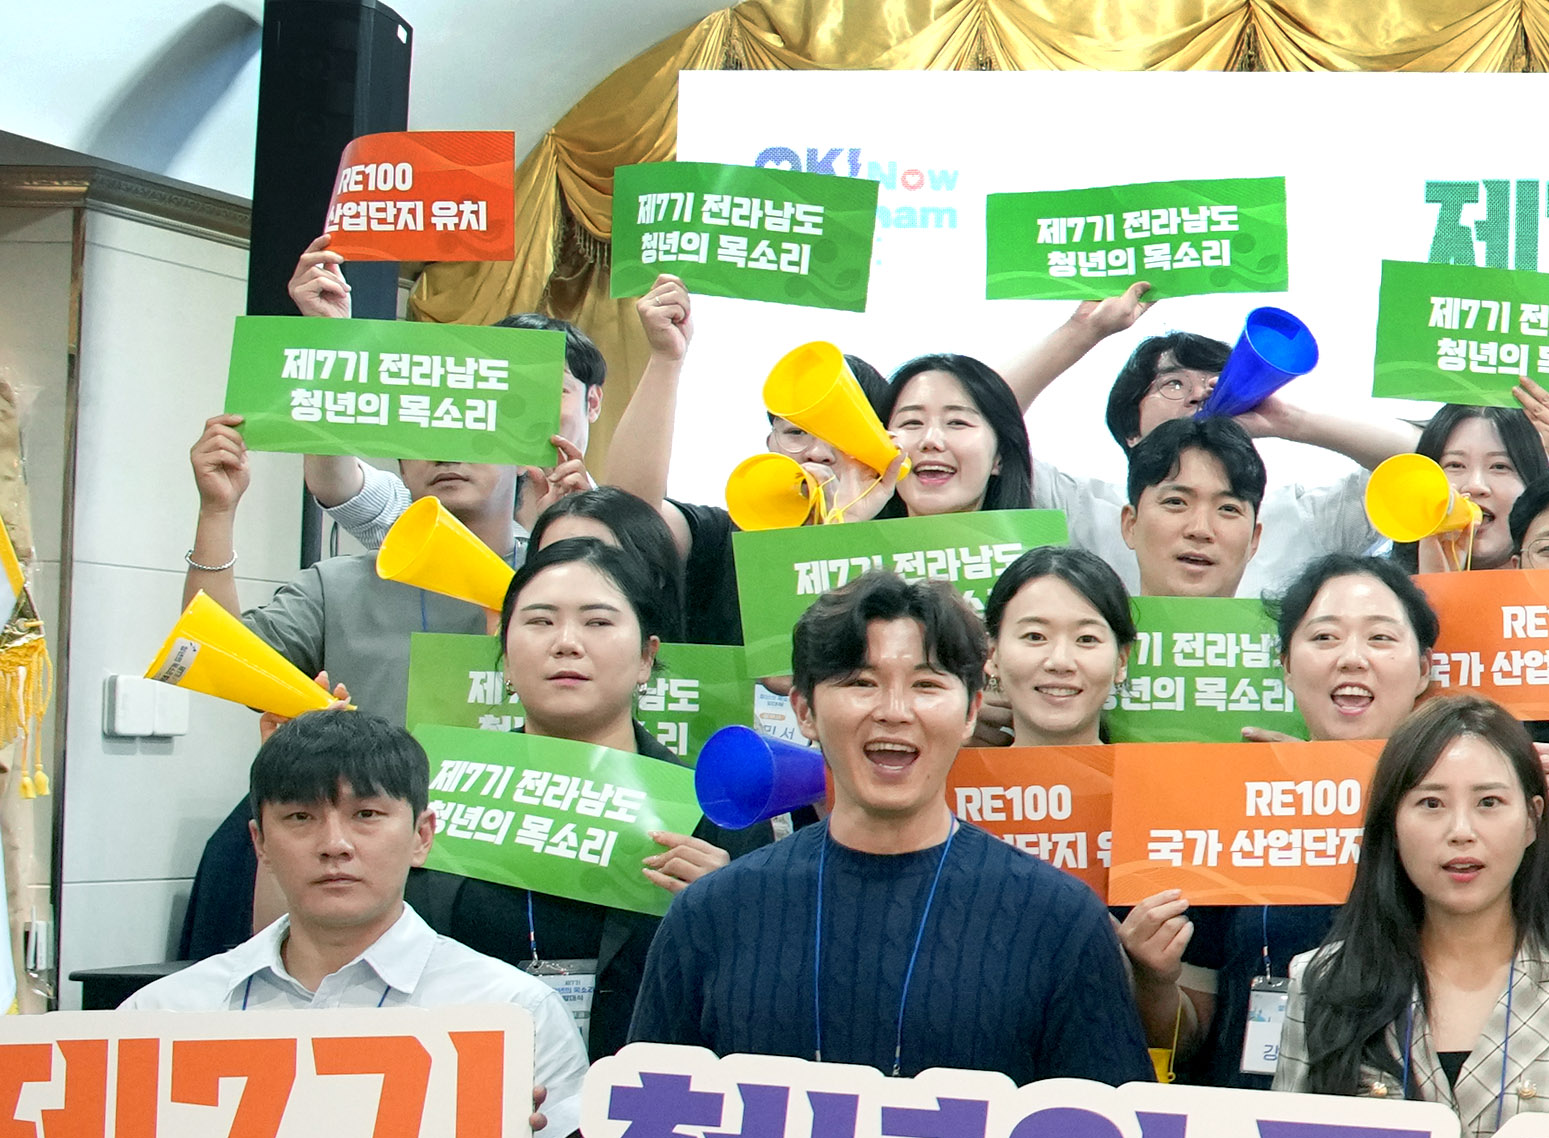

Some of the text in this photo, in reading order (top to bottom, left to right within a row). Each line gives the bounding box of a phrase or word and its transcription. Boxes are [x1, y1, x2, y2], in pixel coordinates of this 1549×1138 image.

[337, 161, 414, 194] RE100
[867, 161, 959, 191] Now
[431, 200, 488, 233] 유치
[636, 193, 825, 236] 제7기 전라남도
[1036, 204, 1240, 247] 제7기 전라남도
[641, 232, 811, 275] 청년의 목소리
[1047, 239, 1231, 280] 청년의 목소리
[1429, 295, 1511, 332] 제7기
[281, 348, 510, 393] 제7기 전라남도
[1436, 337, 1529, 378] 청년의
[290, 390, 498, 433] 청년의 목소리
[1172, 632, 1281, 668] 전라남
[1195, 676, 1294, 714] 목소리
[429, 759, 648, 825] 제7기 전라남도
[954, 784, 1072, 822] RE100
[1244, 778, 1361, 817] RE100
[428, 799, 619, 869] 청년의 목소리
[998, 830, 1088, 869] 단지
[1147, 829, 1223, 868] 국가
